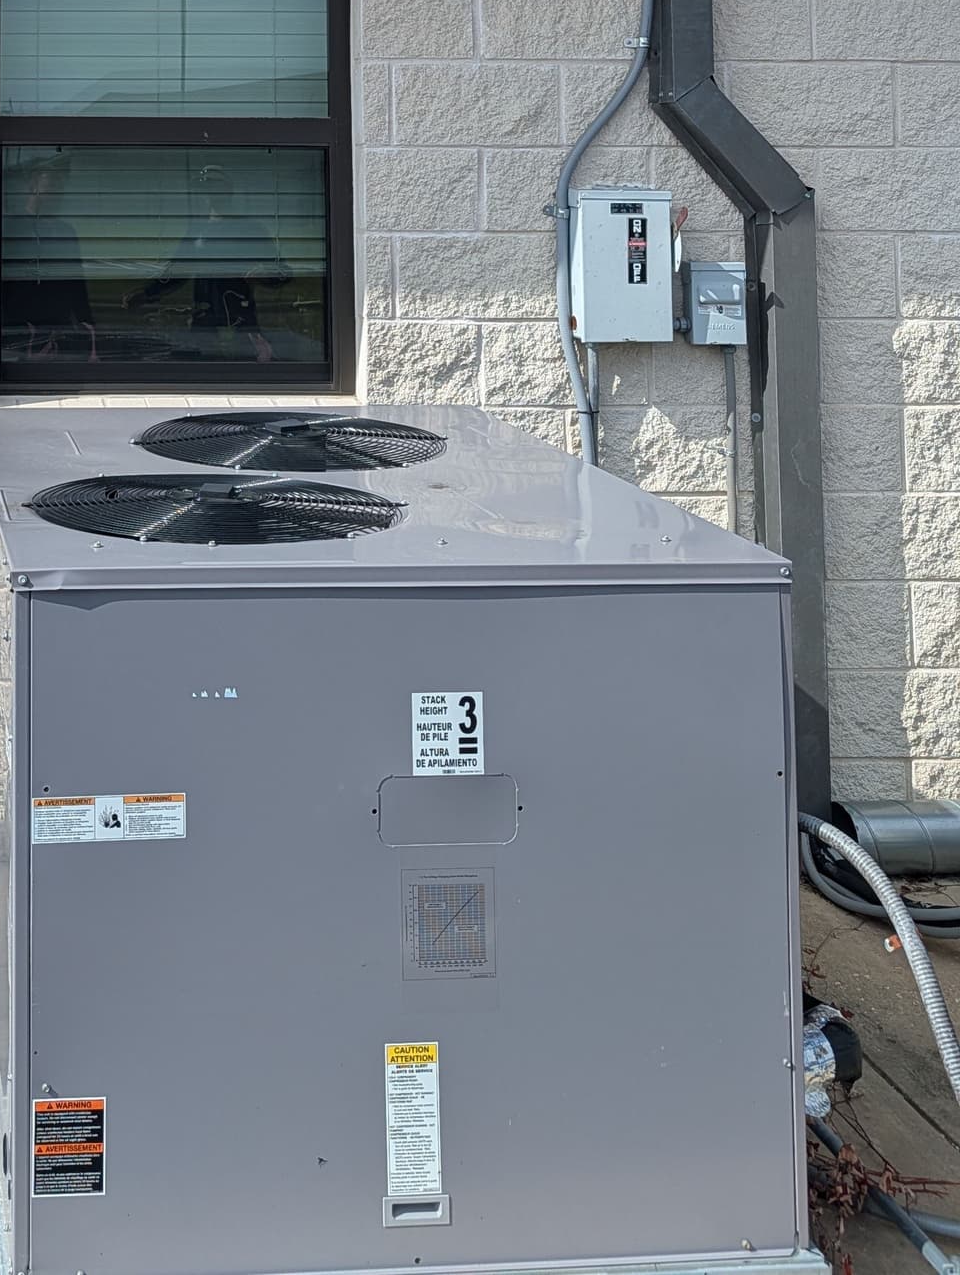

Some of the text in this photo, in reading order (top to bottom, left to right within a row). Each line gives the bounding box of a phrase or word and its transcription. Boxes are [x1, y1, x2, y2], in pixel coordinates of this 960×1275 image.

[421, 695, 446, 704] STACK
[420, 706, 448, 715] HEIGHT
[459, 695, 477, 734] 3
[416, 722, 452, 731] HAUTEUR
[421, 732, 448, 741] DE PILE
[420, 748, 449, 757] ALTURA
[416, 758, 477, 768] DE APILAMIENTO
[394, 1045, 429, 1054] CAUTION
[390, 1054, 433, 1062] ATTENTION
[55, 1101, 92, 1109] WARNING
[46, 1144, 101, 1153] AVERTISSEMENT
